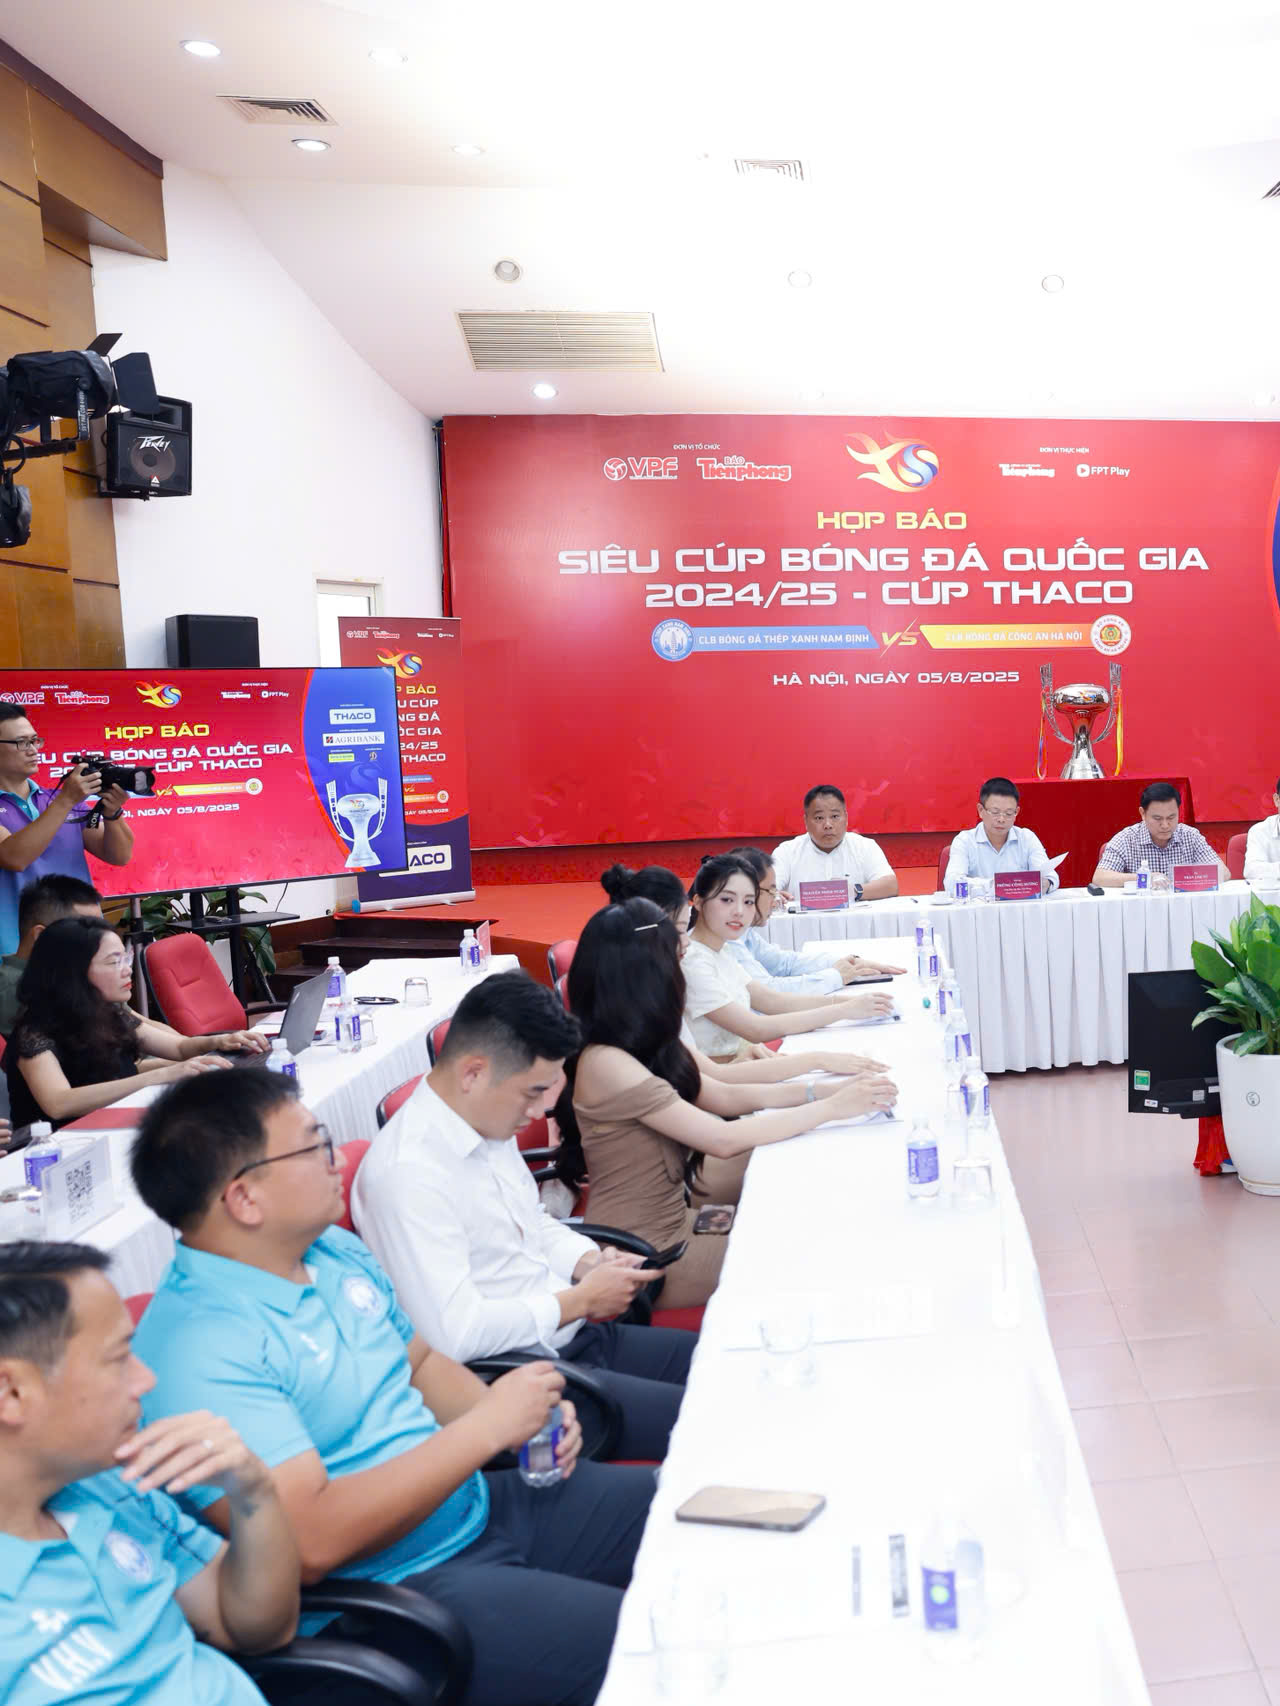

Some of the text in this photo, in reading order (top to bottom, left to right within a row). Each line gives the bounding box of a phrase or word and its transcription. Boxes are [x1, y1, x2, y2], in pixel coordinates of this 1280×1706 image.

[628, 457, 678, 477] VPF
[1091, 466, 1130, 477] FPT Play
[817, 507, 967, 534] HỌP BÁO
[558, 537, 1209, 574] SIÊU CÚP BÓNG ĐÁ QUỐC GIA
[645, 581, 837, 608] 2024/25
[881, 576, 969, 605] CÚP
[983, 580, 1133, 605] THACO
[699, 633, 869, 645] CLB BÓNG ĐÁ THÉP XANH NAM ĐỊNH
[881, 631, 920, 646] VS
[1036, 632, 1049, 641] AN
[1066, 630, 1083, 642] NỘI
[773, 670, 1020, 687] HÀ NỘI, NGÀY 05/8/2025
[406, 684, 437, 694] BÁO
[409, 697, 439, 708] CÚP
[334, 713, 371, 721] THACO
[418, 711, 440, 721] ĐÁ
[105, 722, 210, 741] HỌP BÁO
[417, 727, 442, 736] GIA
[335, 735, 381, 744] AGRIBANK
[110, 746, 167, 760] BÓNG
[172, 745, 201, 759] ĐÁ
[206, 741, 258, 756] QUỐC
[263, 743, 293, 755] GIA
[155, 758, 262, 772] CÚP THACO
[401, 753, 446, 763] THACO
[137, 806, 172, 817] NGÀY
[177, 803, 240, 815] 05/8/2025
[409, 852, 445, 867] ACO
